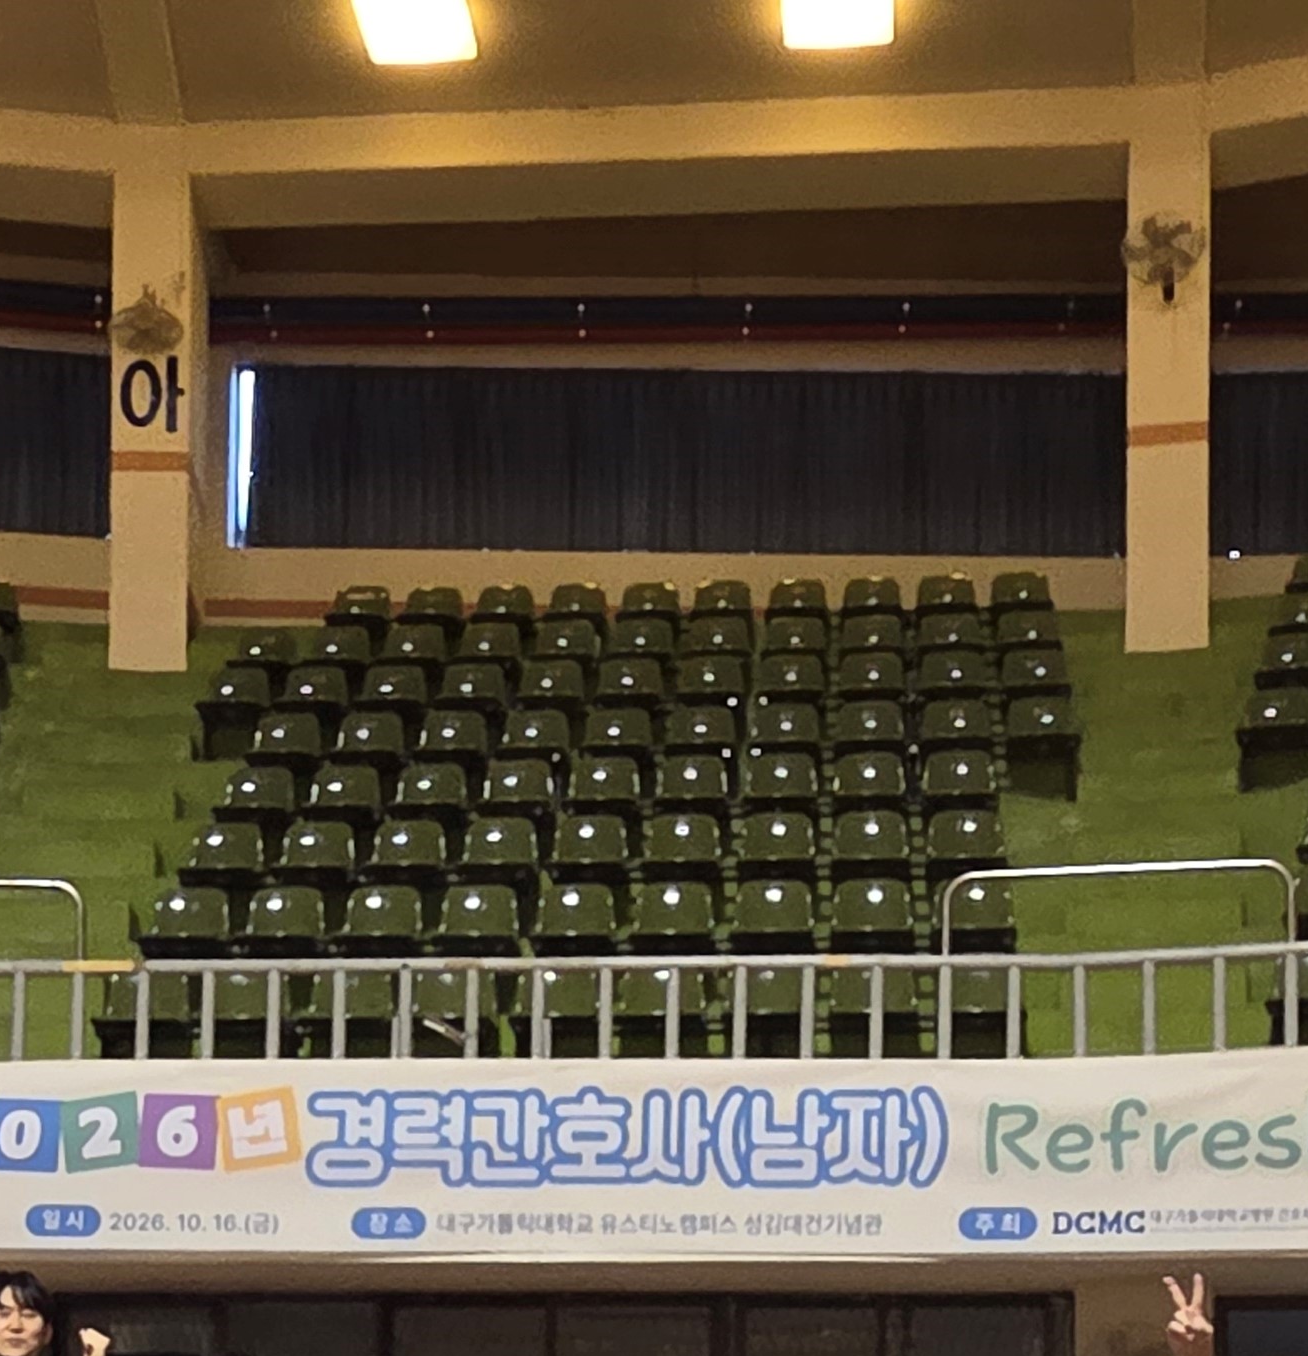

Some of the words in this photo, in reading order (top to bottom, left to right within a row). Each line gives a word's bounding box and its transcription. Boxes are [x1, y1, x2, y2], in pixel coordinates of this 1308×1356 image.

[120, 354, 185, 433] 아
[306, 1086, 949, 1187] 경력간호사(남자)
[109, 1212, 170, 1232] 2026.
[178, 1212, 207, 1232] 10.
[1051, 1210, 1146, 1234] DCMC
